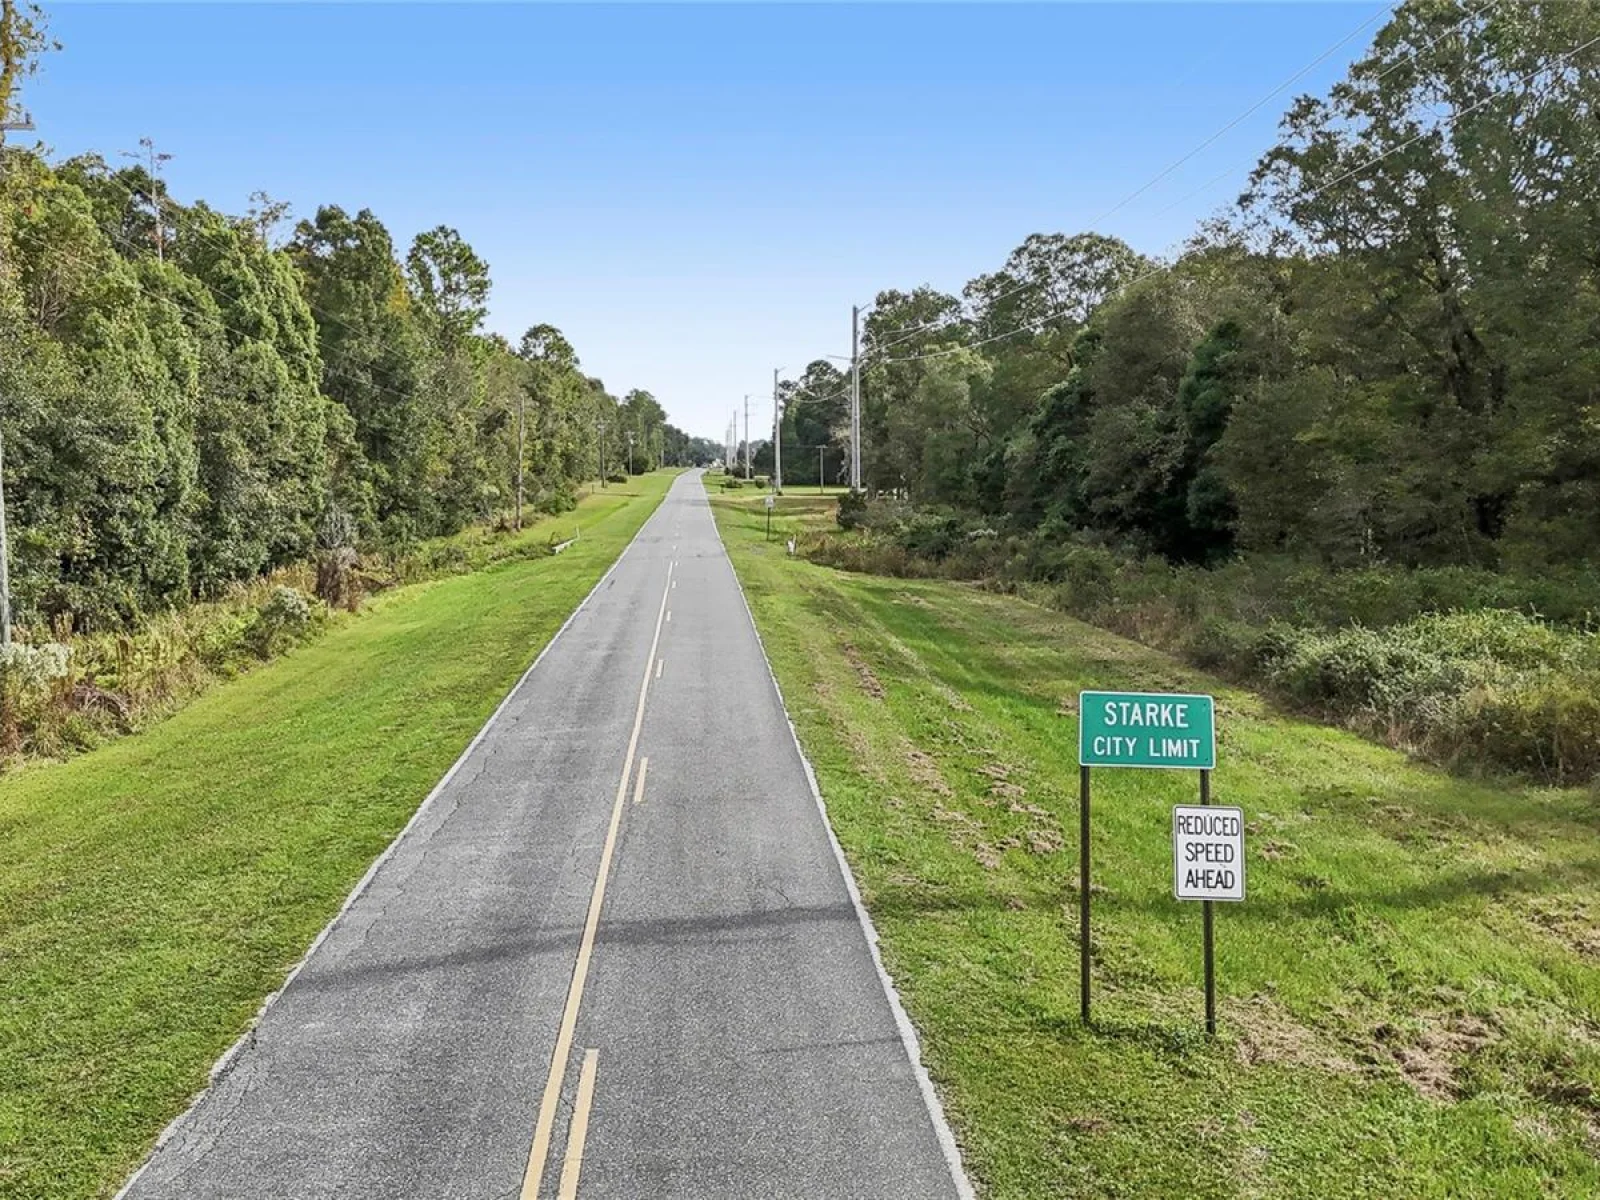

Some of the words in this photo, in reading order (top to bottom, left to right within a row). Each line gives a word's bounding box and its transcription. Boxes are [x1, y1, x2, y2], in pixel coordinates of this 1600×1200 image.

[1104, 702, 1189, 727] STARKE
[1093, 736, 1138, 757] CITY
[1149, 737, 1200, 758] LIMIT
[1178, 815, 1239, 836] REDUCED
[1185, 842, 1234, 863] SPEED
[1185, 869, 1235, 889] AHEAD
